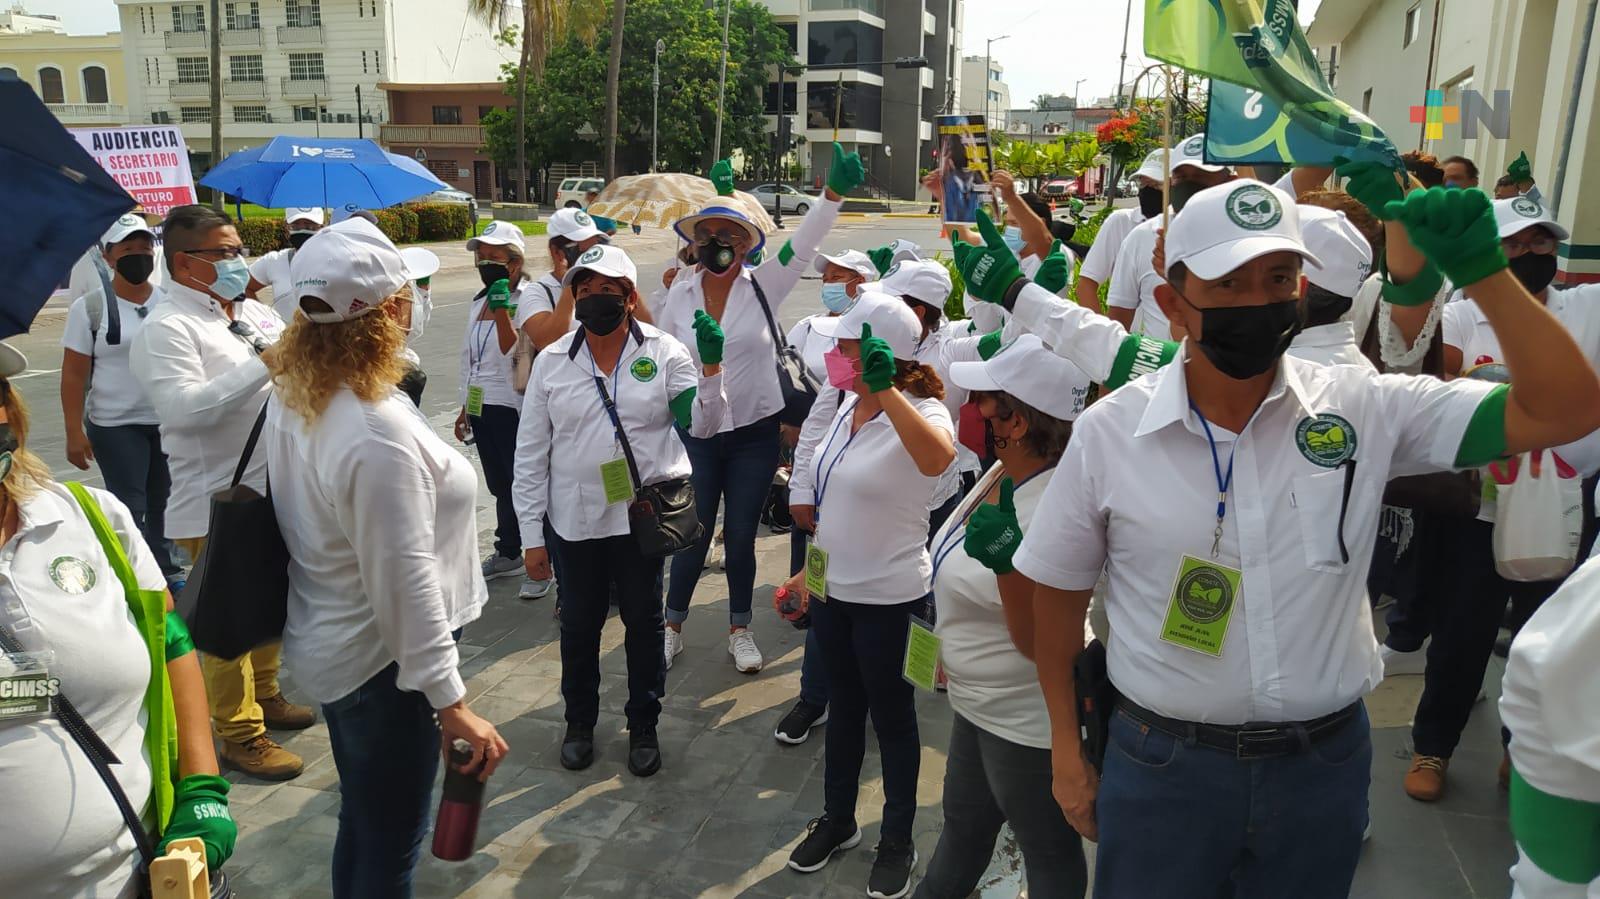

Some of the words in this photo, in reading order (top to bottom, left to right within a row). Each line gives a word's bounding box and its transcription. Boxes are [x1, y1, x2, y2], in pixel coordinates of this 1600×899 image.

[92, 130, 179, 151] AUDIENCIA
[108, 152, 179, 170] SECRETARIO
[112, 171, 163, 187] ACIENDA
[136, 191, 174, 203] RTURO
